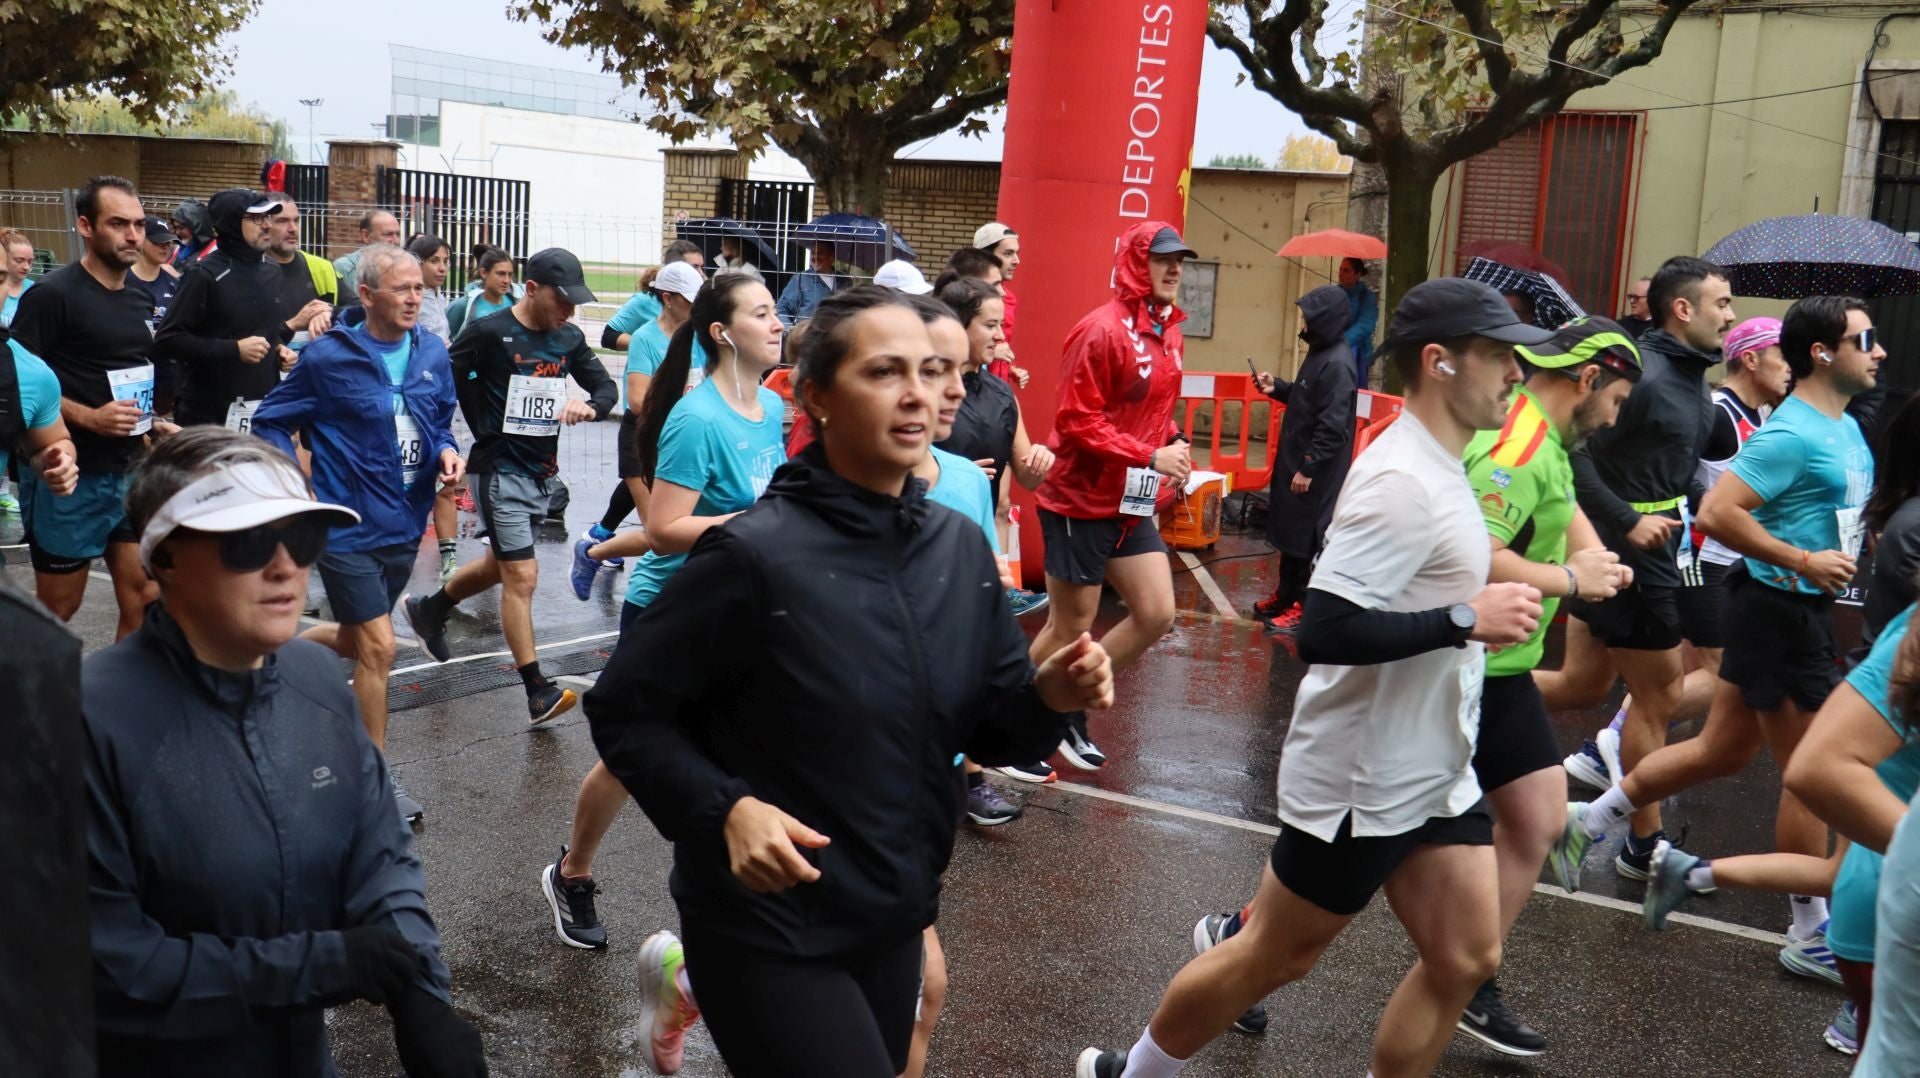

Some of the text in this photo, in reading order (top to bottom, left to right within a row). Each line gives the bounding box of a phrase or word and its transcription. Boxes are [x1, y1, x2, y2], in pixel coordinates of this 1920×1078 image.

[1118, 3, 1174, 219] DEPORTES
[522, 396, 555, 419] 1183
[400, 440, 420, 465] 48
